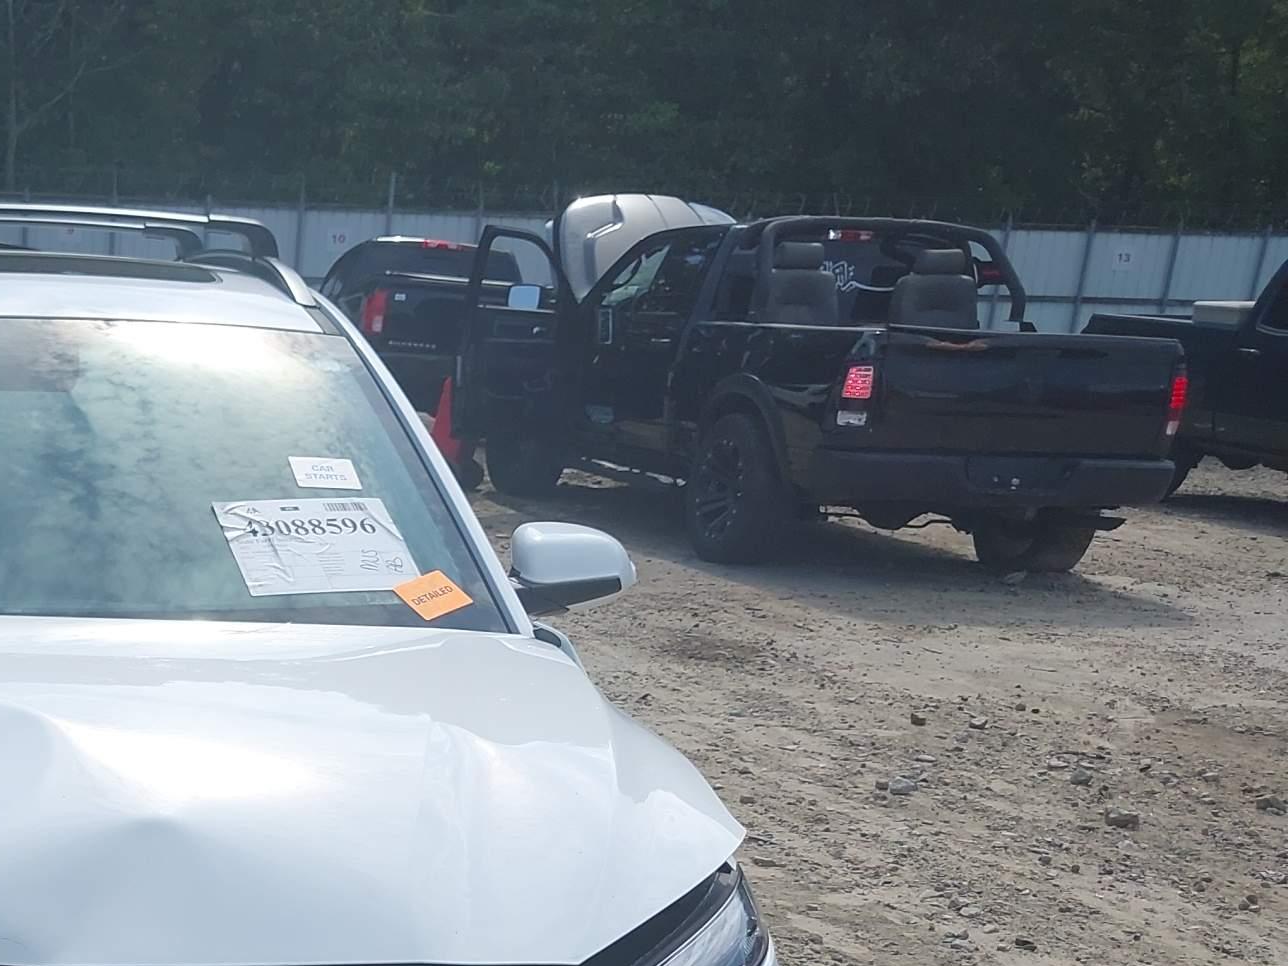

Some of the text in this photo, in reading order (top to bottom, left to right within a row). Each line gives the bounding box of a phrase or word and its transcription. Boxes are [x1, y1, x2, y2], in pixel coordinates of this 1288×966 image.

[331, 233, 347, 245] 10
[1117, 252, 1132, 264] 13
[311, 464, 335, 472] CAR
[305, 472, 348, 481] STARTS
[246, 515, 377, 538] 43088596
[410, 585, 455, 606] DETAILED
